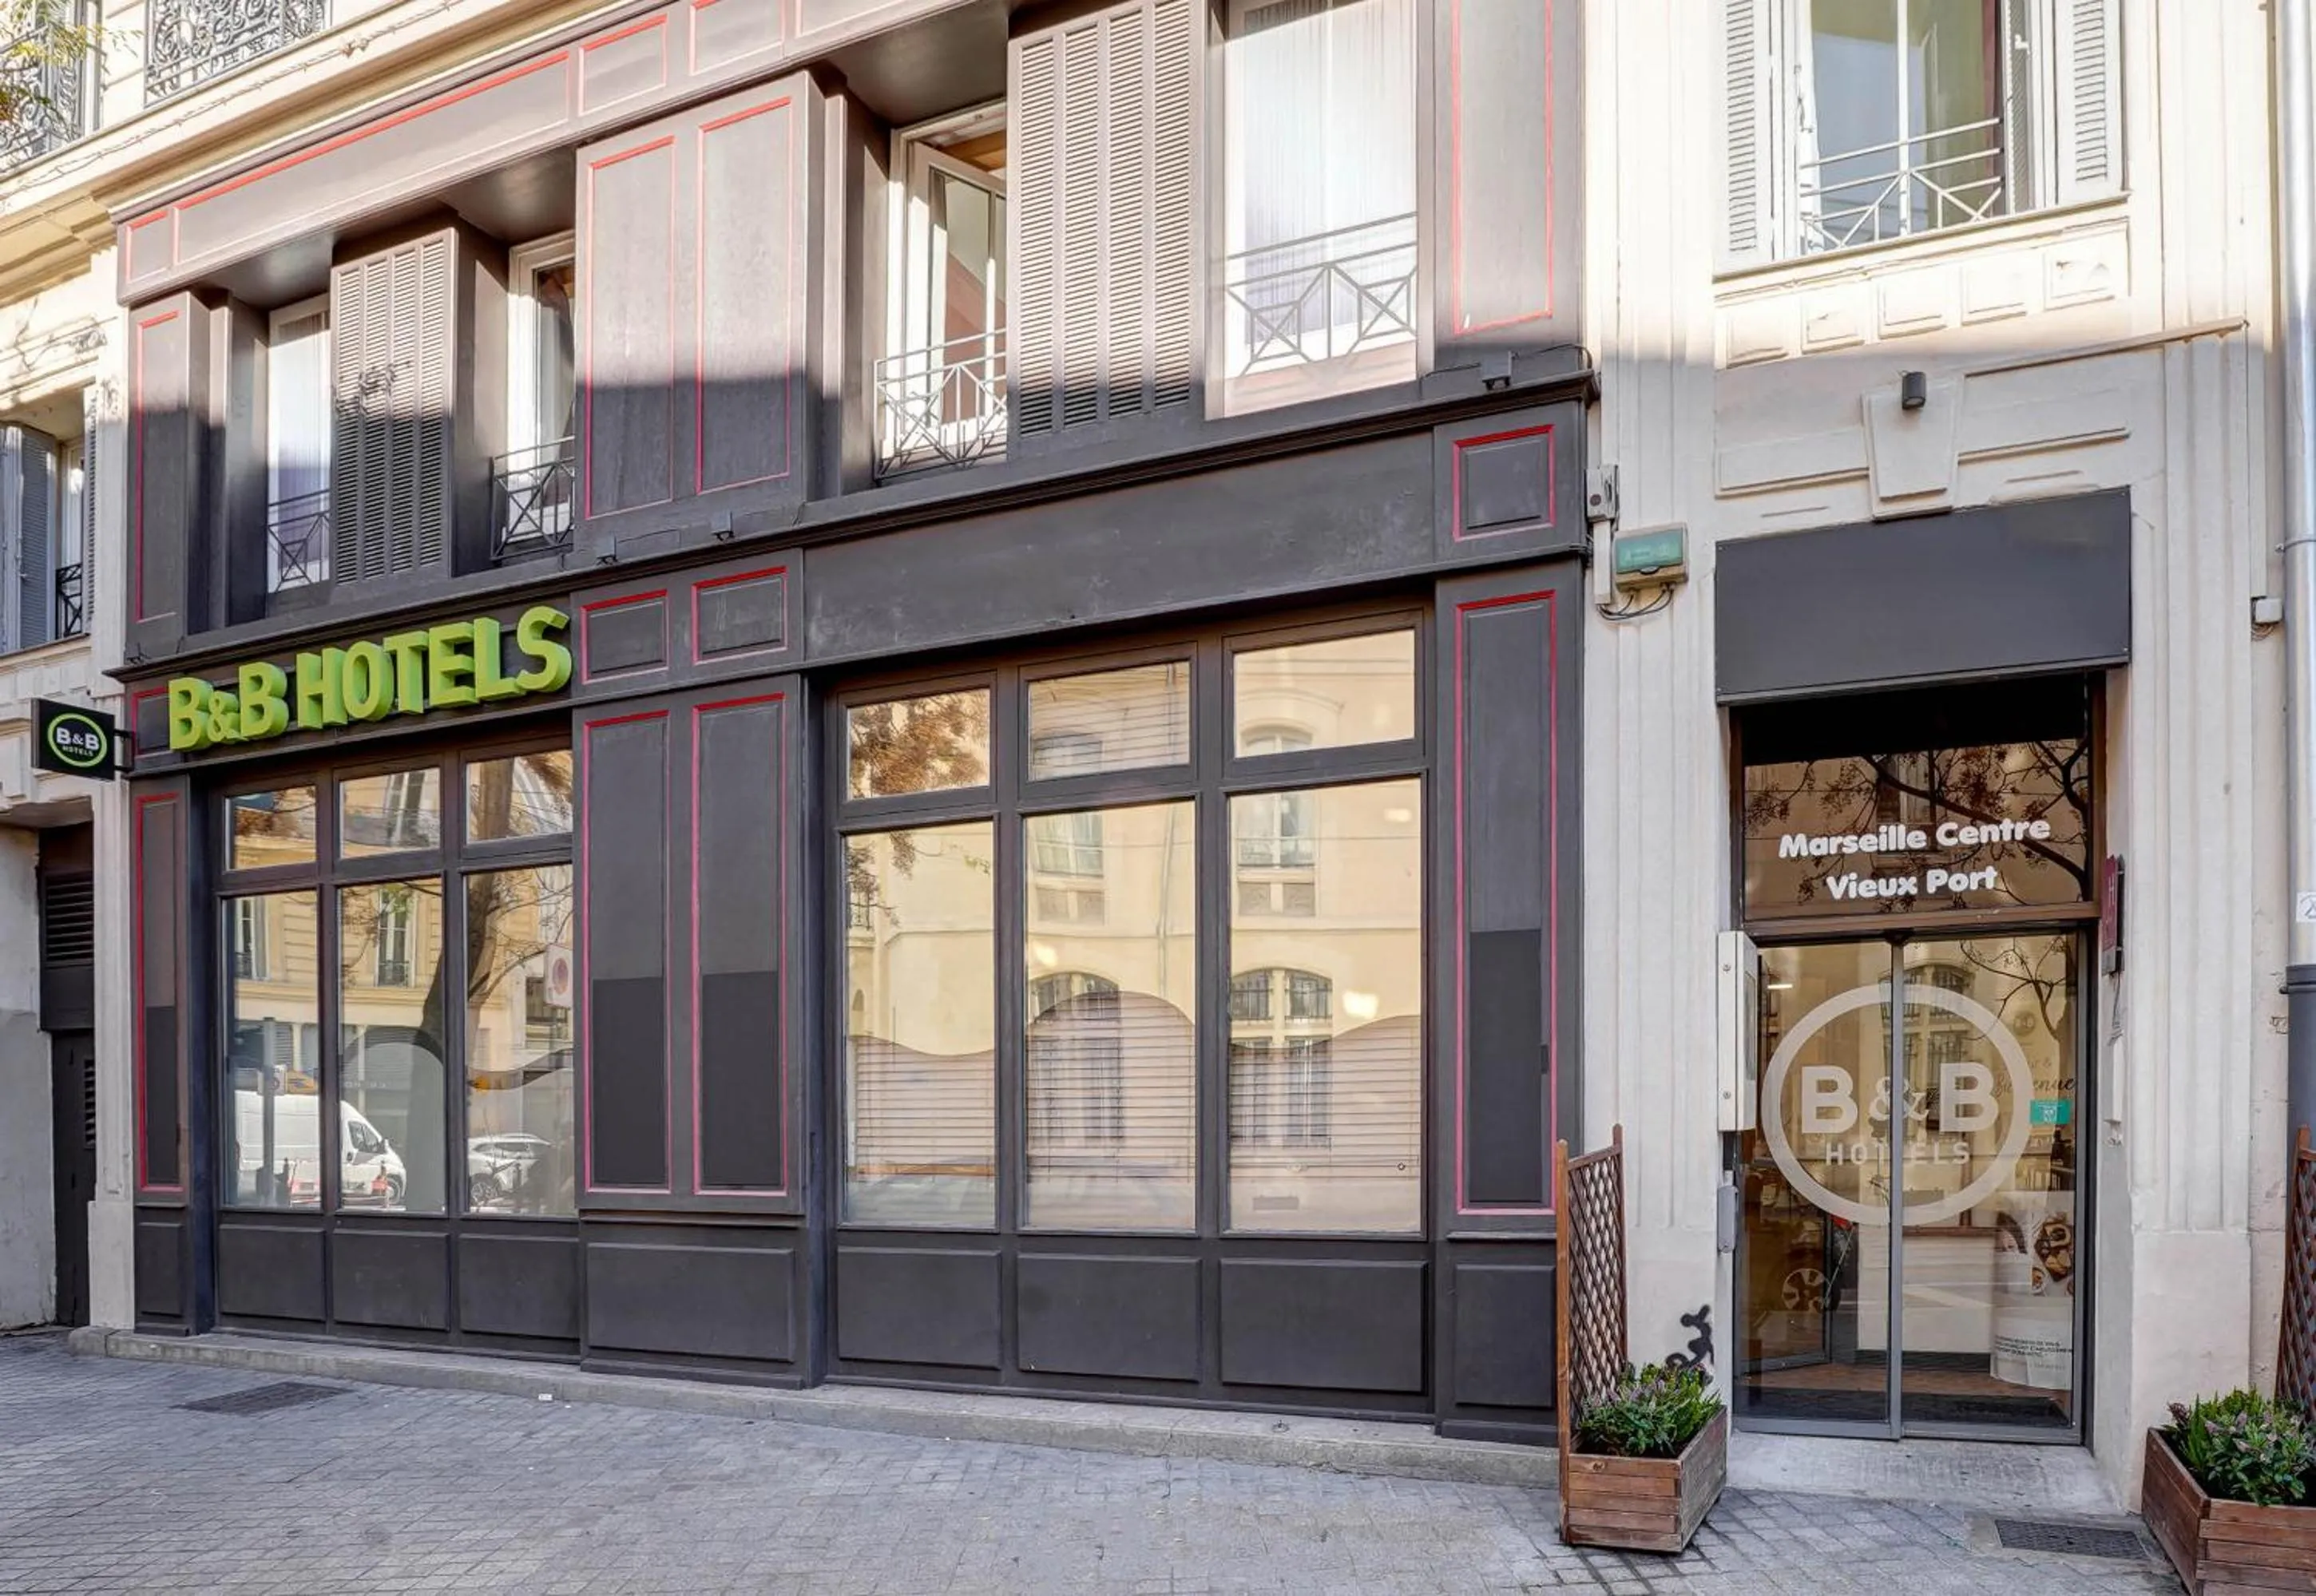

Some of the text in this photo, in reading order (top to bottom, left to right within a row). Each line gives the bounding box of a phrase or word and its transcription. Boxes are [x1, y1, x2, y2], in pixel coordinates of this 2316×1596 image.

[169, 606, 573, 751] B&B HOTELS
[56, 727, 100, 750] B&B
[1779, 818, 2051, 858] Marseille Centre
[1826, 865, 1998, 900] Vieux Port
[1802, 1062, 2000, 1134] B&B
[1824, 1141, 1970, 1166] HOTELS
